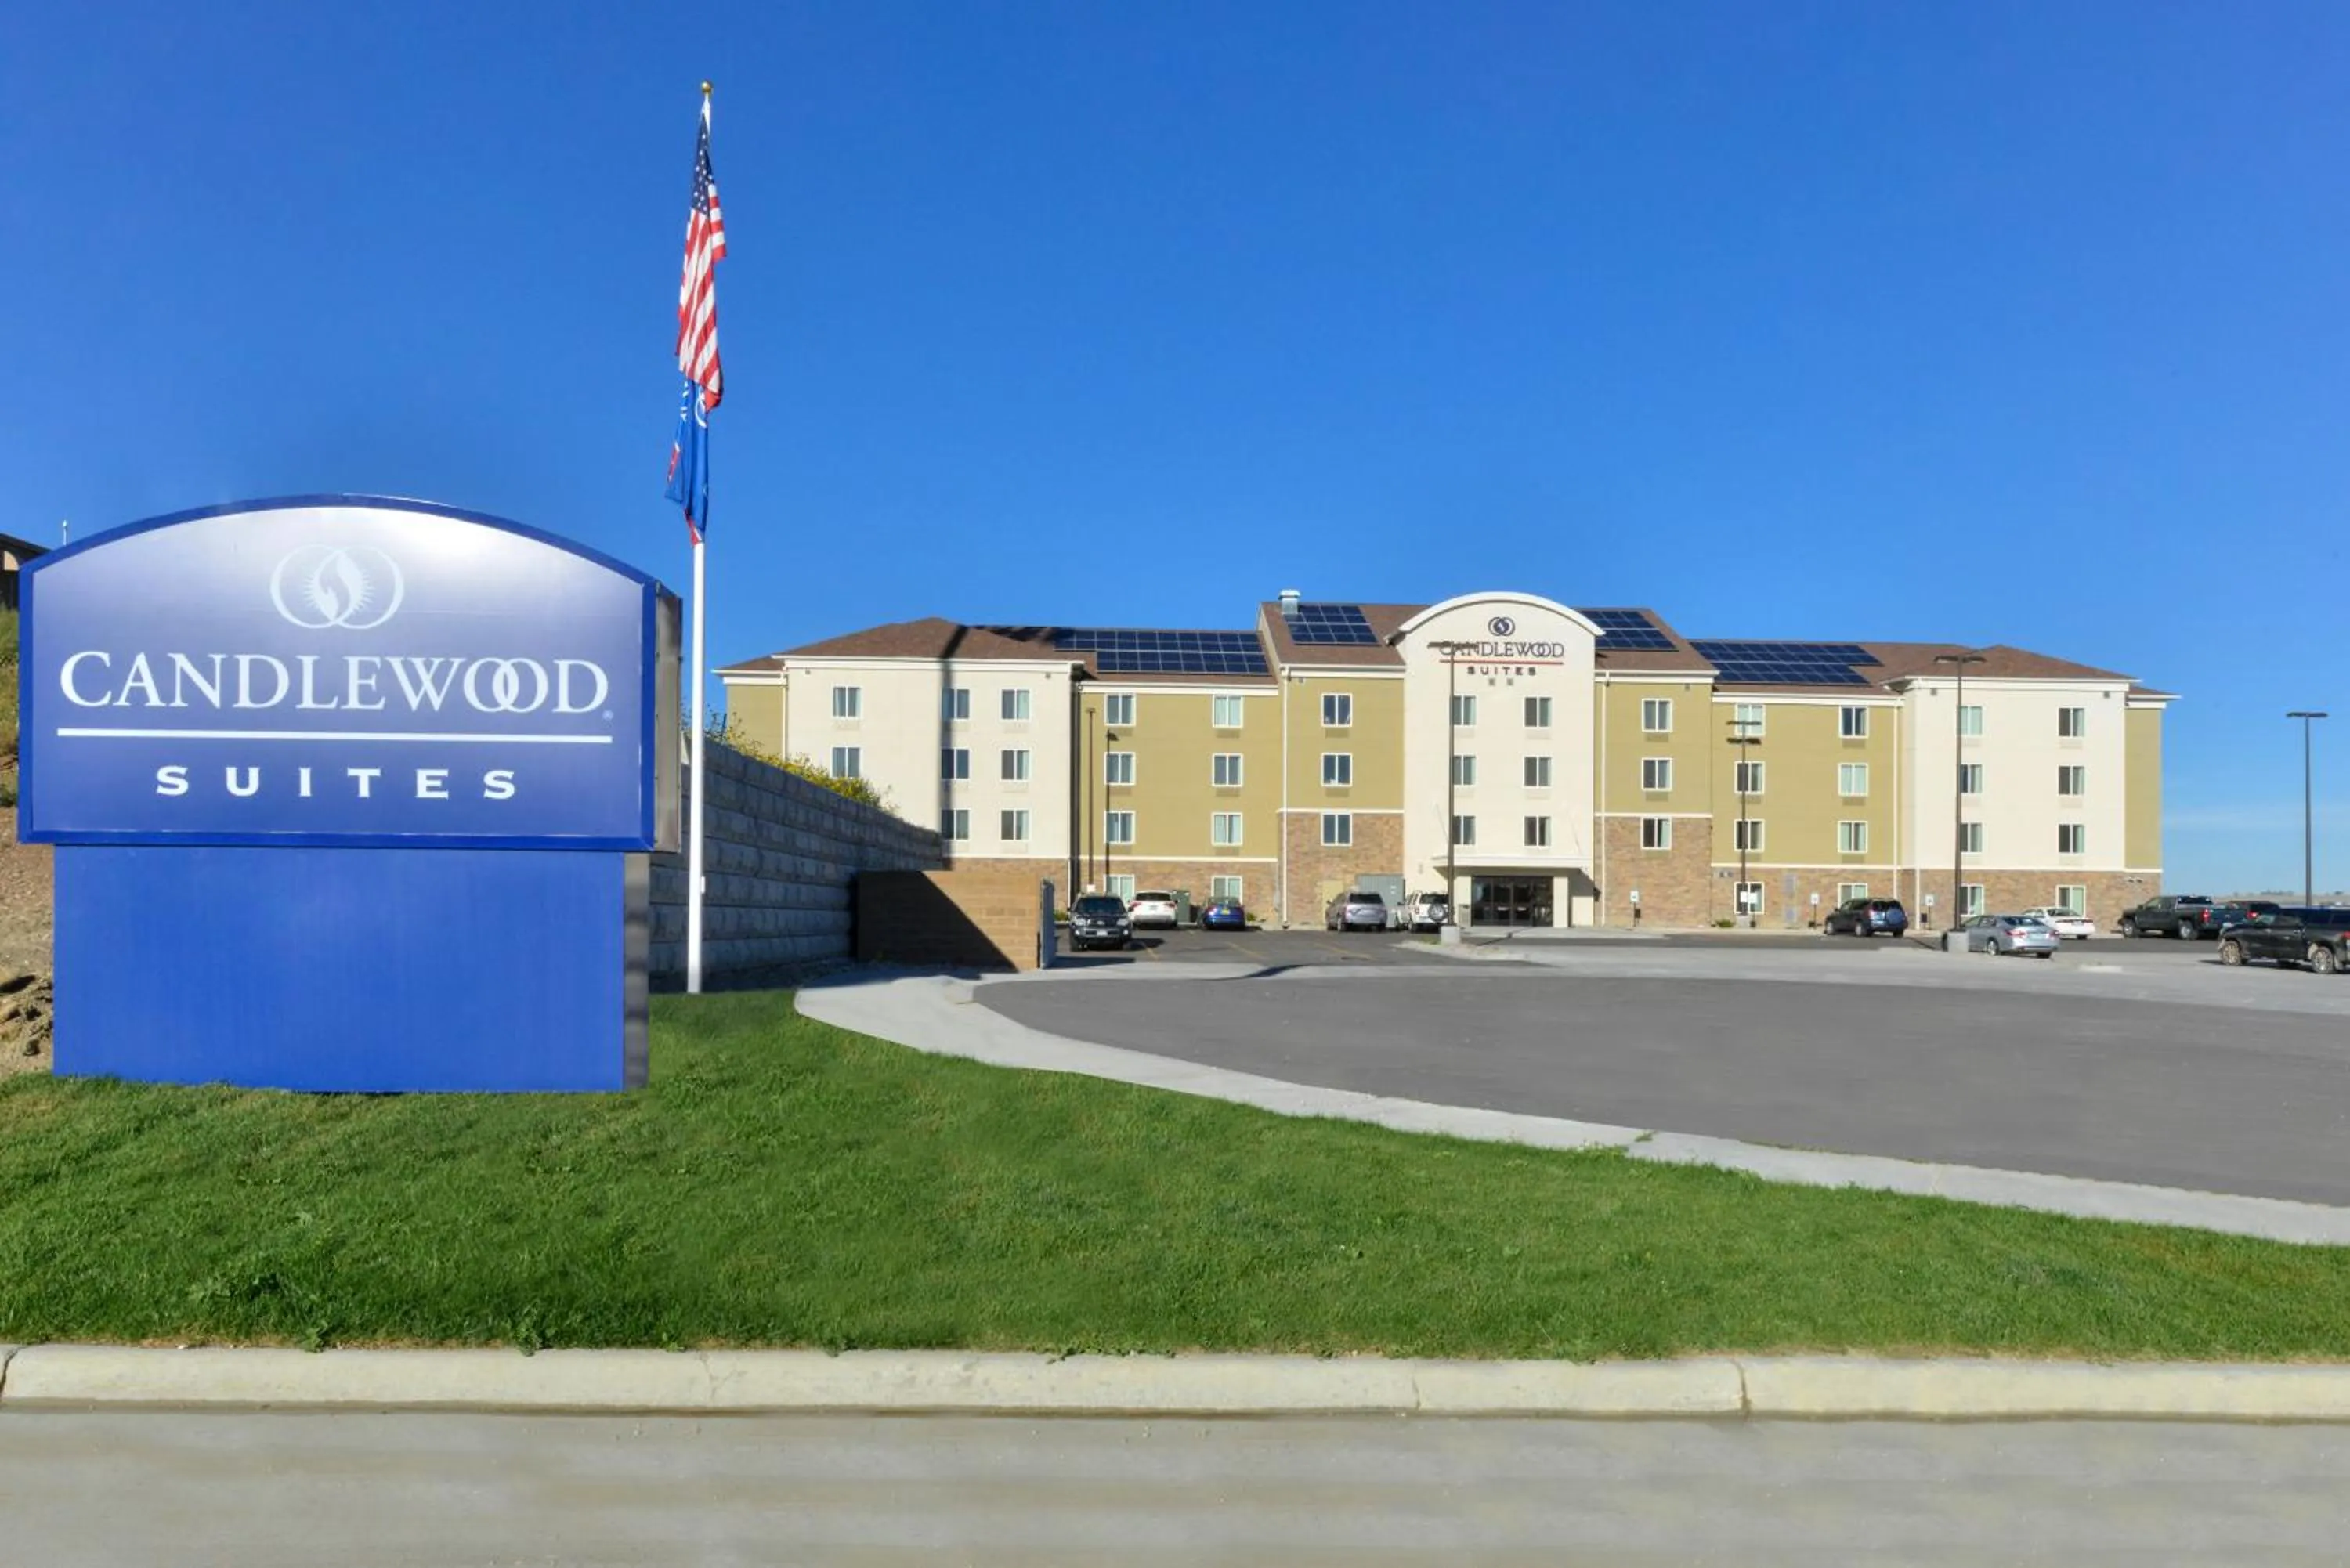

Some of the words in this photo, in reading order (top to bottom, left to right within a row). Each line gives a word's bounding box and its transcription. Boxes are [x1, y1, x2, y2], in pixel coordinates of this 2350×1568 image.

[60, 651, 609, 714] CANDLEWOOD
[1466, 666, 1537, 676] SUITES
[156, 765, 516, 800] SUITES
